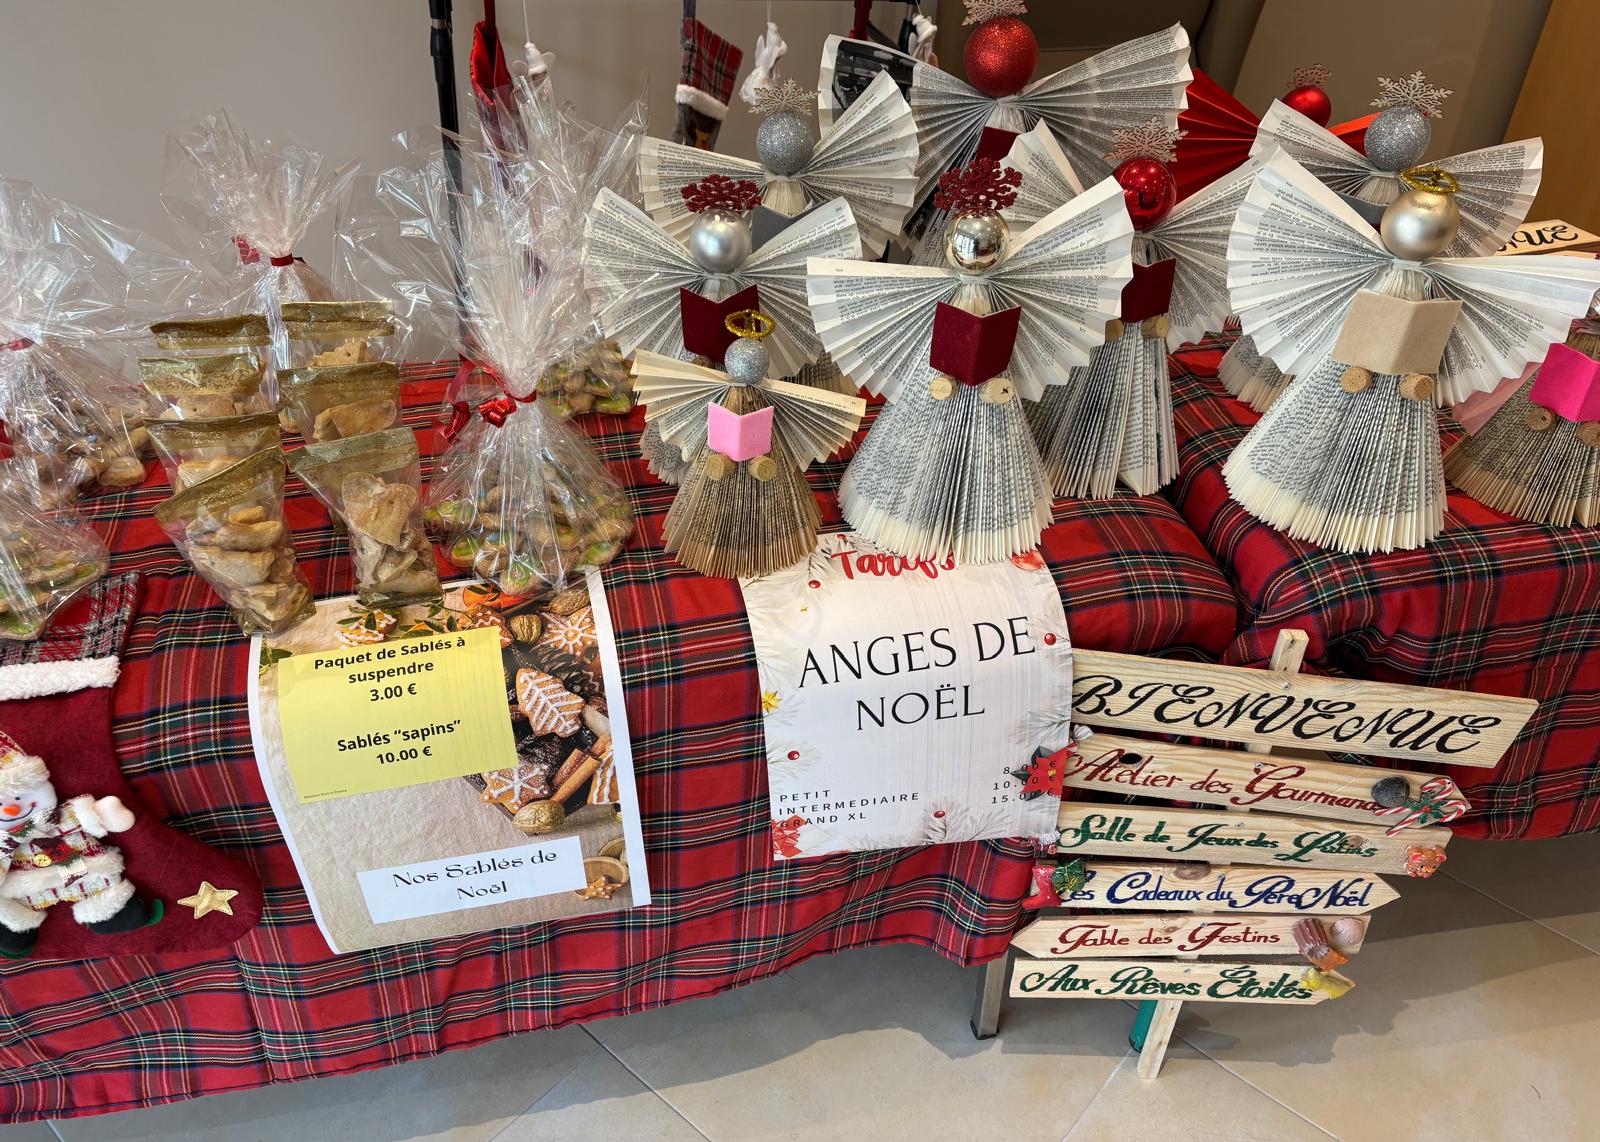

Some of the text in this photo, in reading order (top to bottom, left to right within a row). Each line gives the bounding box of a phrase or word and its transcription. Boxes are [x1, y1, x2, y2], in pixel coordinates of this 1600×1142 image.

[314, 637, 466, 670] Paquet de Sablés à
[799, 616, 1036, 688] ANGES DE
[348, 661, 435, 684] suspendre
[370, 682, 418, 702] 3.00 €
[856, 684, 986, 731] NOËL
[1072, 674, 1502, 754] BIENVENUE
[337, 734, 391, 752] Sablés
[376, 745, 433, 765] 10.00 €
[1003, 760, 1057, 775] 8.00 €
[1065, 748, 1183, 789] Atelier
[1190, 768, 1232, 794] des
[780, 789, 831, 802] PETIT
[993, 776, 1039, 791] 10.00
[779, 792, 919, 816] INTERMEDIAIRE
[991, 791, 1037, 805] 15.00
[780, 811, 867, 828] GRAND XL
[1057, 813, 1378, 863] Salle de Jeux des Lutins
[392, 849, 557, 888] Nos Sablés de
[456, 880, 508, 900] Noël
[1106, 871, 1204, 905] Cadeaux
[1206, 876, 1233, 901] du
[1296, 877, 1374, 910] Noël
[1050, 922, 1280, 955] Table des Festins
[1019, 964, 1313, 999] Aux Rêves Étoilés
